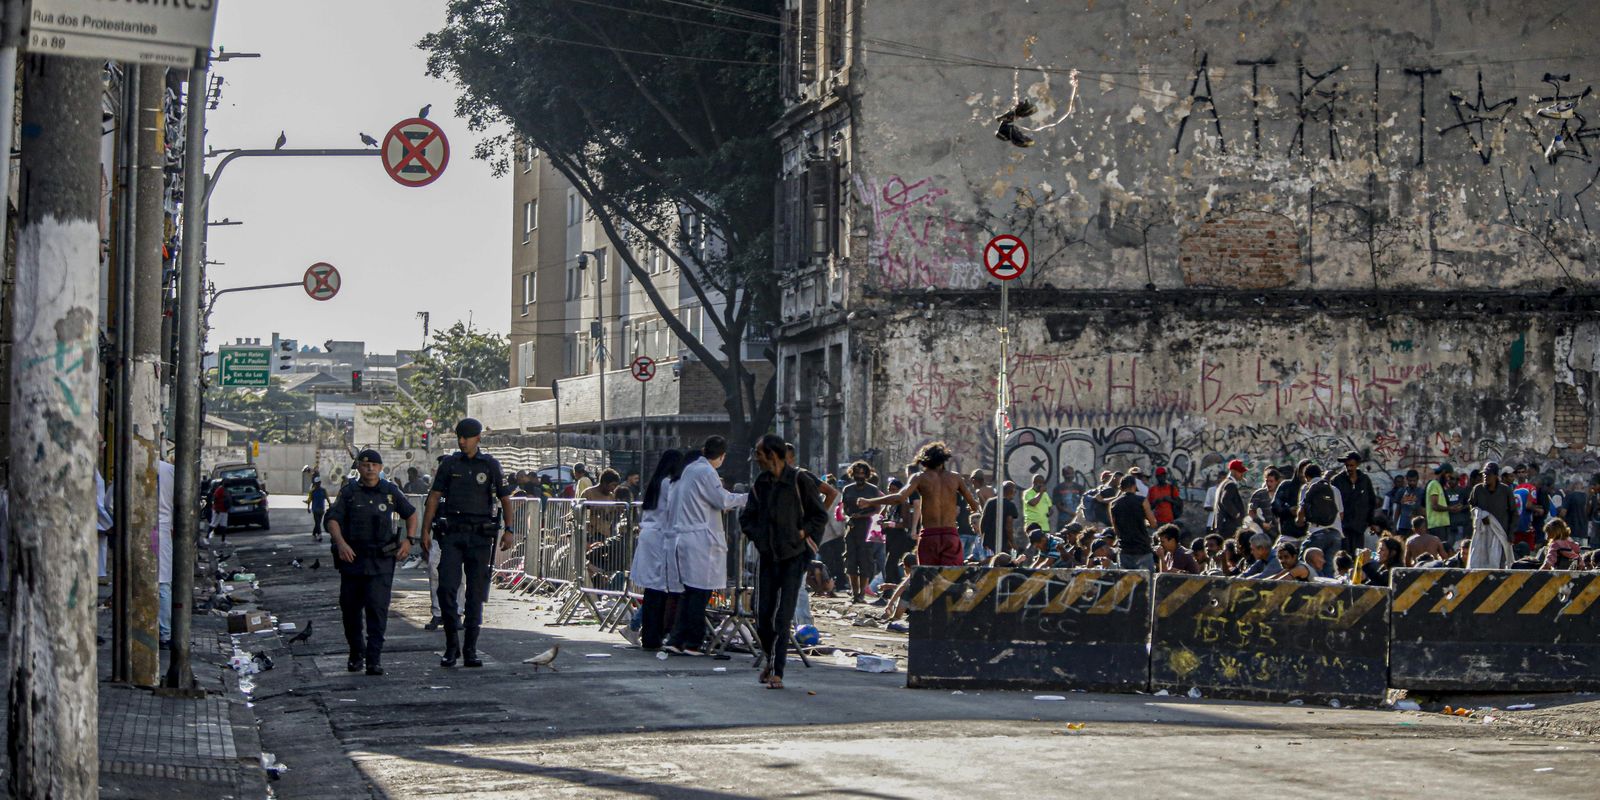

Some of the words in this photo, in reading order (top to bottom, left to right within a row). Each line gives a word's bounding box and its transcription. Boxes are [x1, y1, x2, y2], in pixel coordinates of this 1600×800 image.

[33, 10, 53, 23] Rua
[57, 15, 78, 27] dos
[82, 15, 158, 35] Protestantes
[32, 36, 38, 47] 9
[41, 39, 47, 48] a
[51, 37, 65, 49] 89
